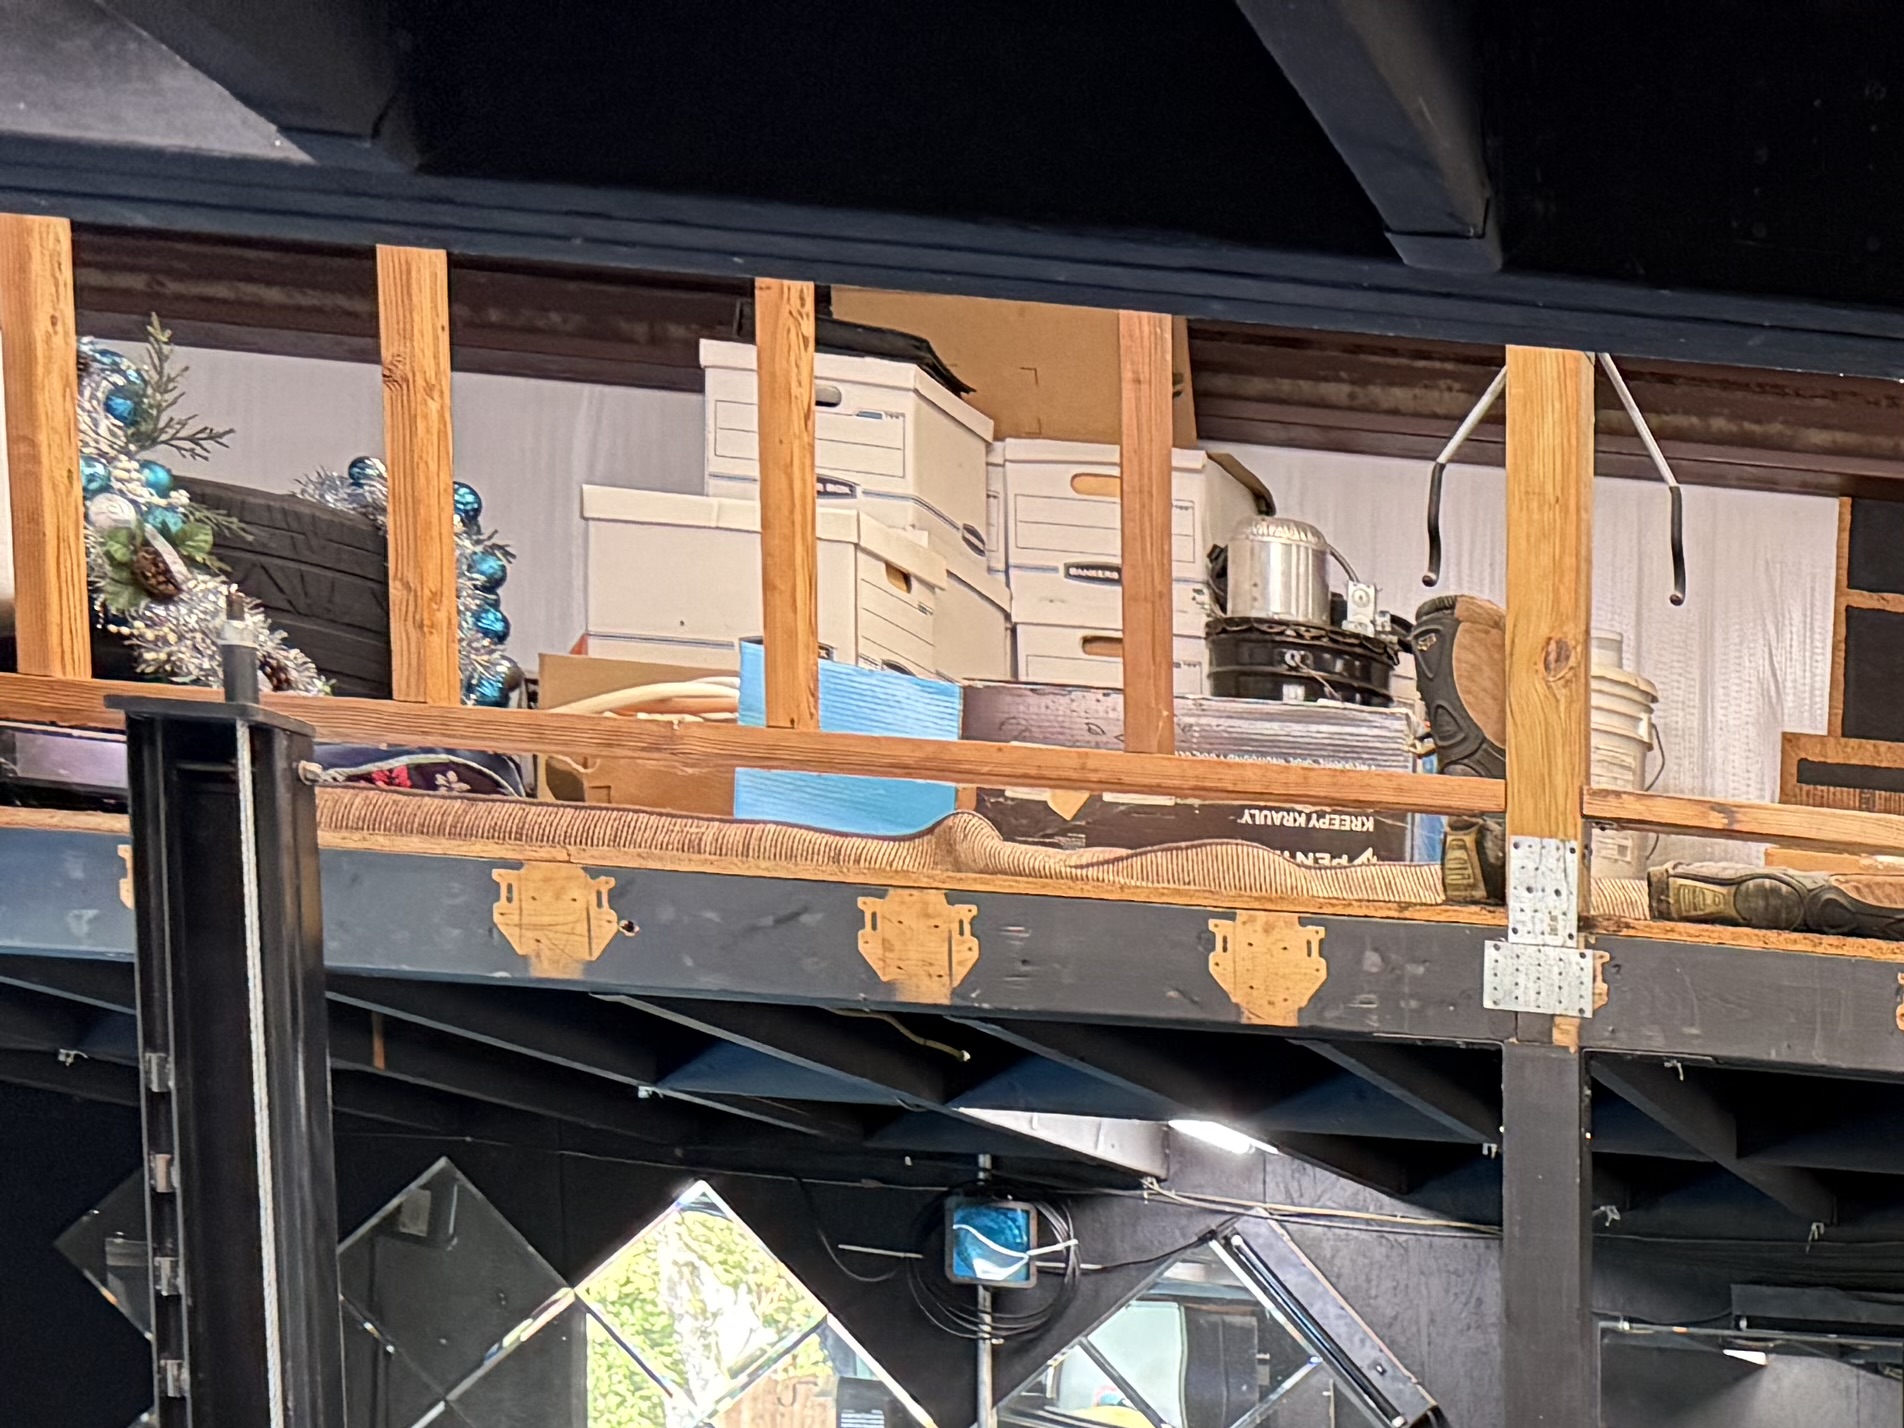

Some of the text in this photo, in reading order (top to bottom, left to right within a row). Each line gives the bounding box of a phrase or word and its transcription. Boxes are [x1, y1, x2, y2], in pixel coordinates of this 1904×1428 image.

[1068, 566, 1119, 580] BANKERS
[1238, 808, 1375, 833] KREEPY KRAULY
